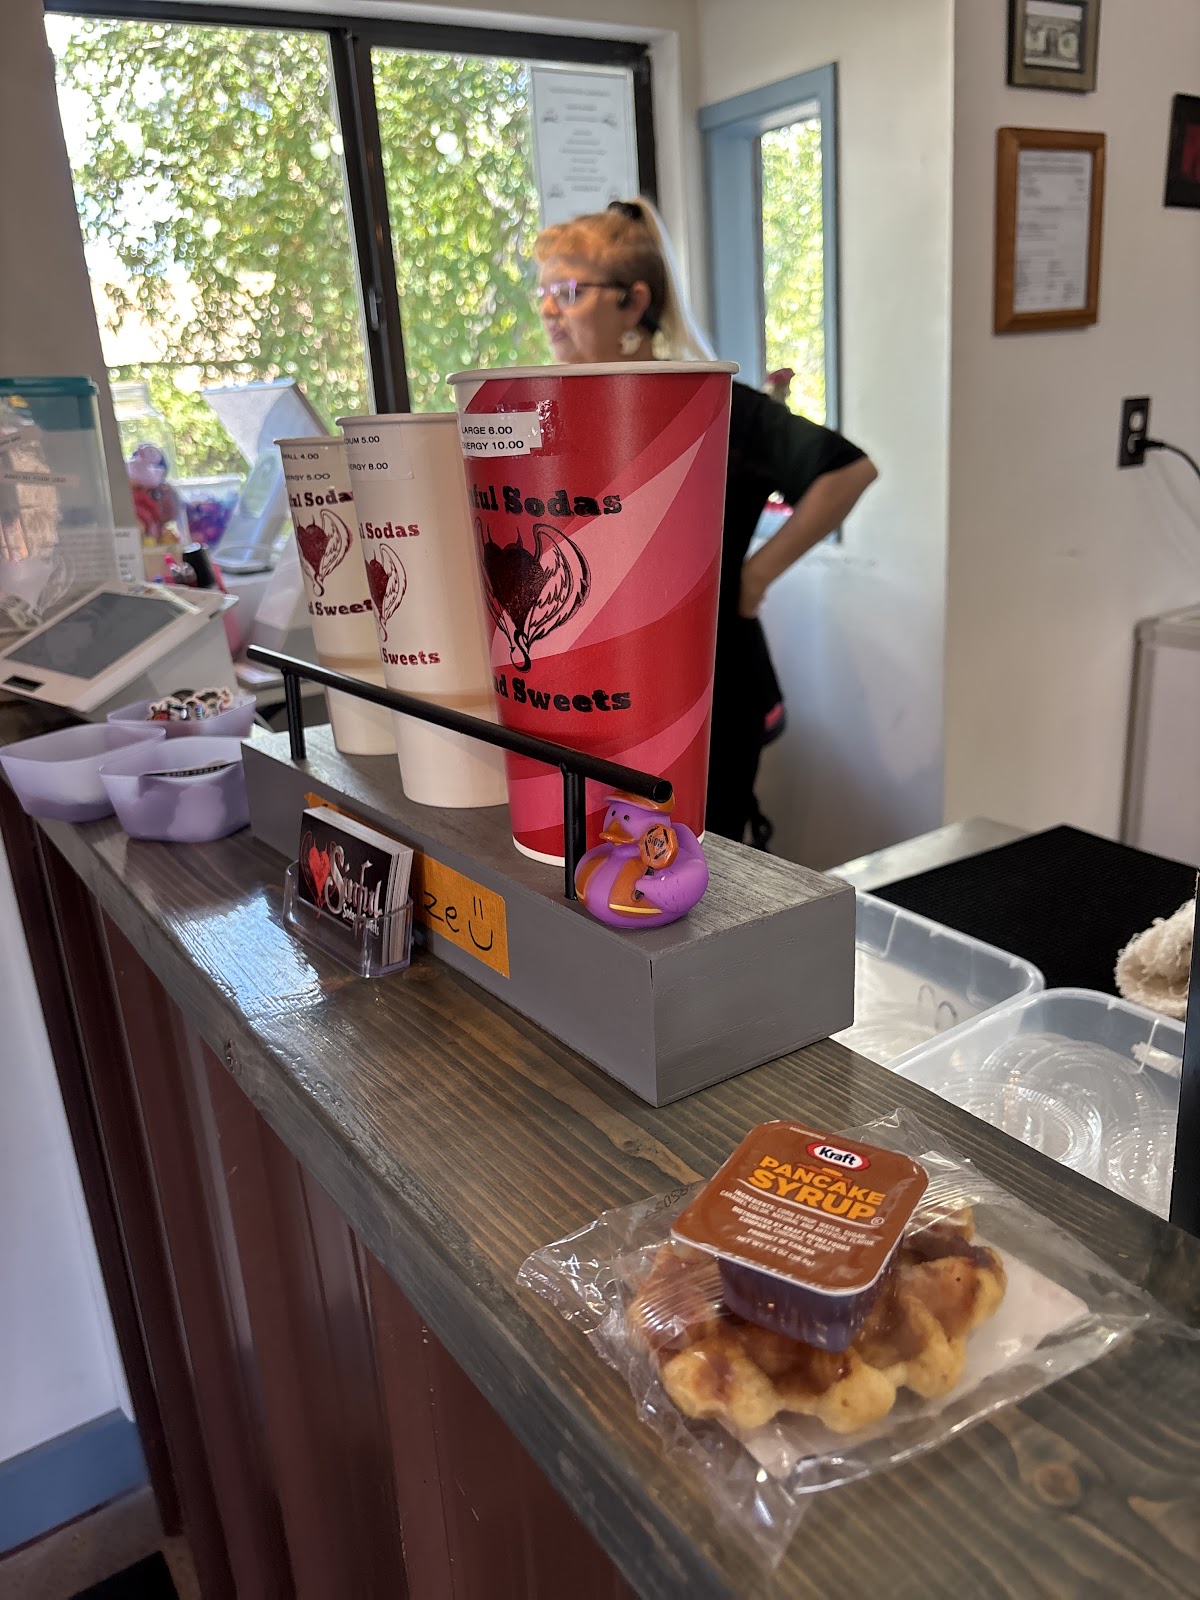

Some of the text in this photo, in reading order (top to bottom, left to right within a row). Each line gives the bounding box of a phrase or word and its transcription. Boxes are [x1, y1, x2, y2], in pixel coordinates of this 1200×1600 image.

[361, 435, 380, 444] 5.00
[488, 426, 513, 435] 6.00
[492, 440, 524, 450] 10.00
[300, 453, 320, 461] 4.00
[368, 462, 389, 471] 8.00
[306, 473, 331, 481] 5.00
[304, 489, 354, 507] Soda
[502, 485, 623, 518] Sodas
[365, 521, 420, 539] Sodas
[315, 599, 373, 616] Sweet
[382, 647, 441, 666] Sweets
[512, 677, 632, 713] Sweets
[324, 845, 384, 918] Sinful
[818, 1146, 857, 1165] Kraft
[759, 1156, 886, 1205] PANCAKE
[747, 1168, 877, 1221] SYRUP
[783, 1224, 807, 1236] KRAFT
[747, 1228, 779, 1242] PRODUCT
[788, 1240, 816, 1256] CANADA
